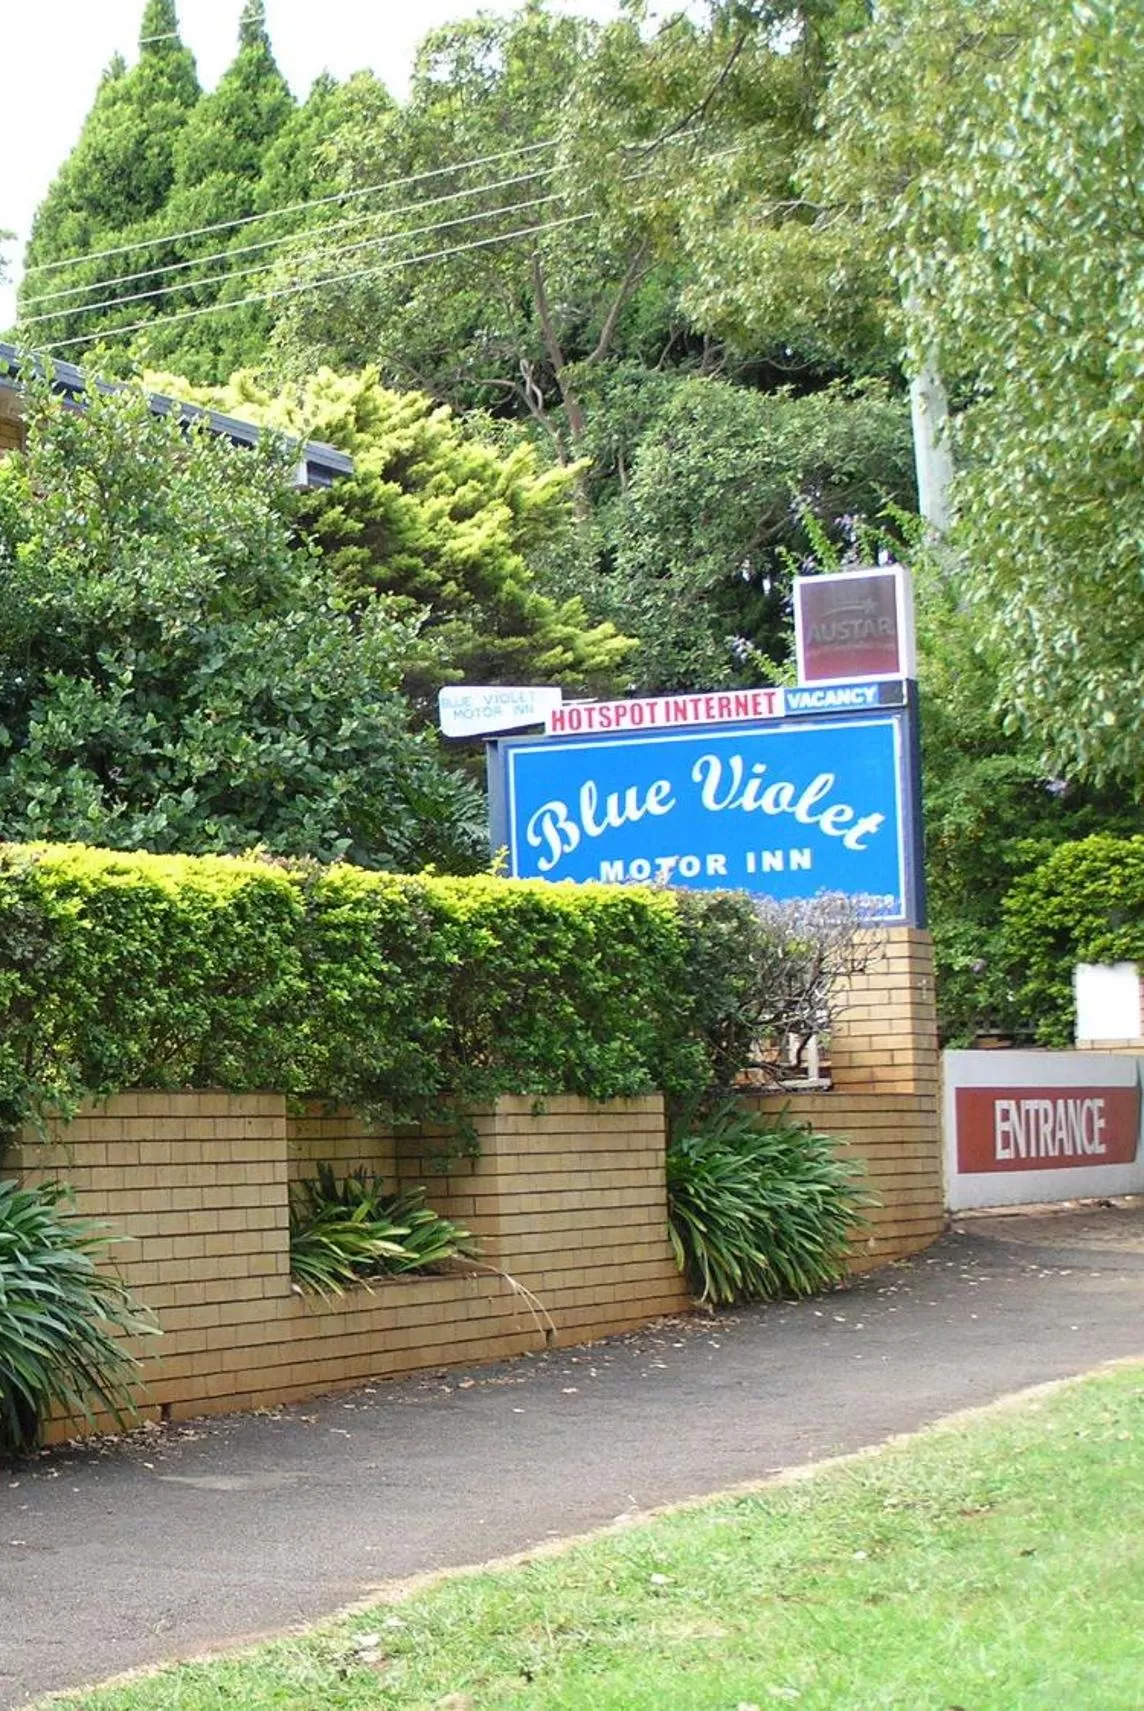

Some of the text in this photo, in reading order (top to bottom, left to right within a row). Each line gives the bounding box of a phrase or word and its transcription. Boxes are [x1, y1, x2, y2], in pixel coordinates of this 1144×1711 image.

[808, 617, 894, 645] AUSTAR
[441, 690, 536, 710] BLUE VIOLET
[453, 705, 503, 720] MOTOR
[551, 691, 777, 732] HOTSPOT INTERNET
[787, 683, 878, 711] VACANCY
[525, 754, 886, 872] Blue Violet
[599, 847, 812, 884] MOTOR INN
[993, 1098, 1106, 1160] ENTRANCE
